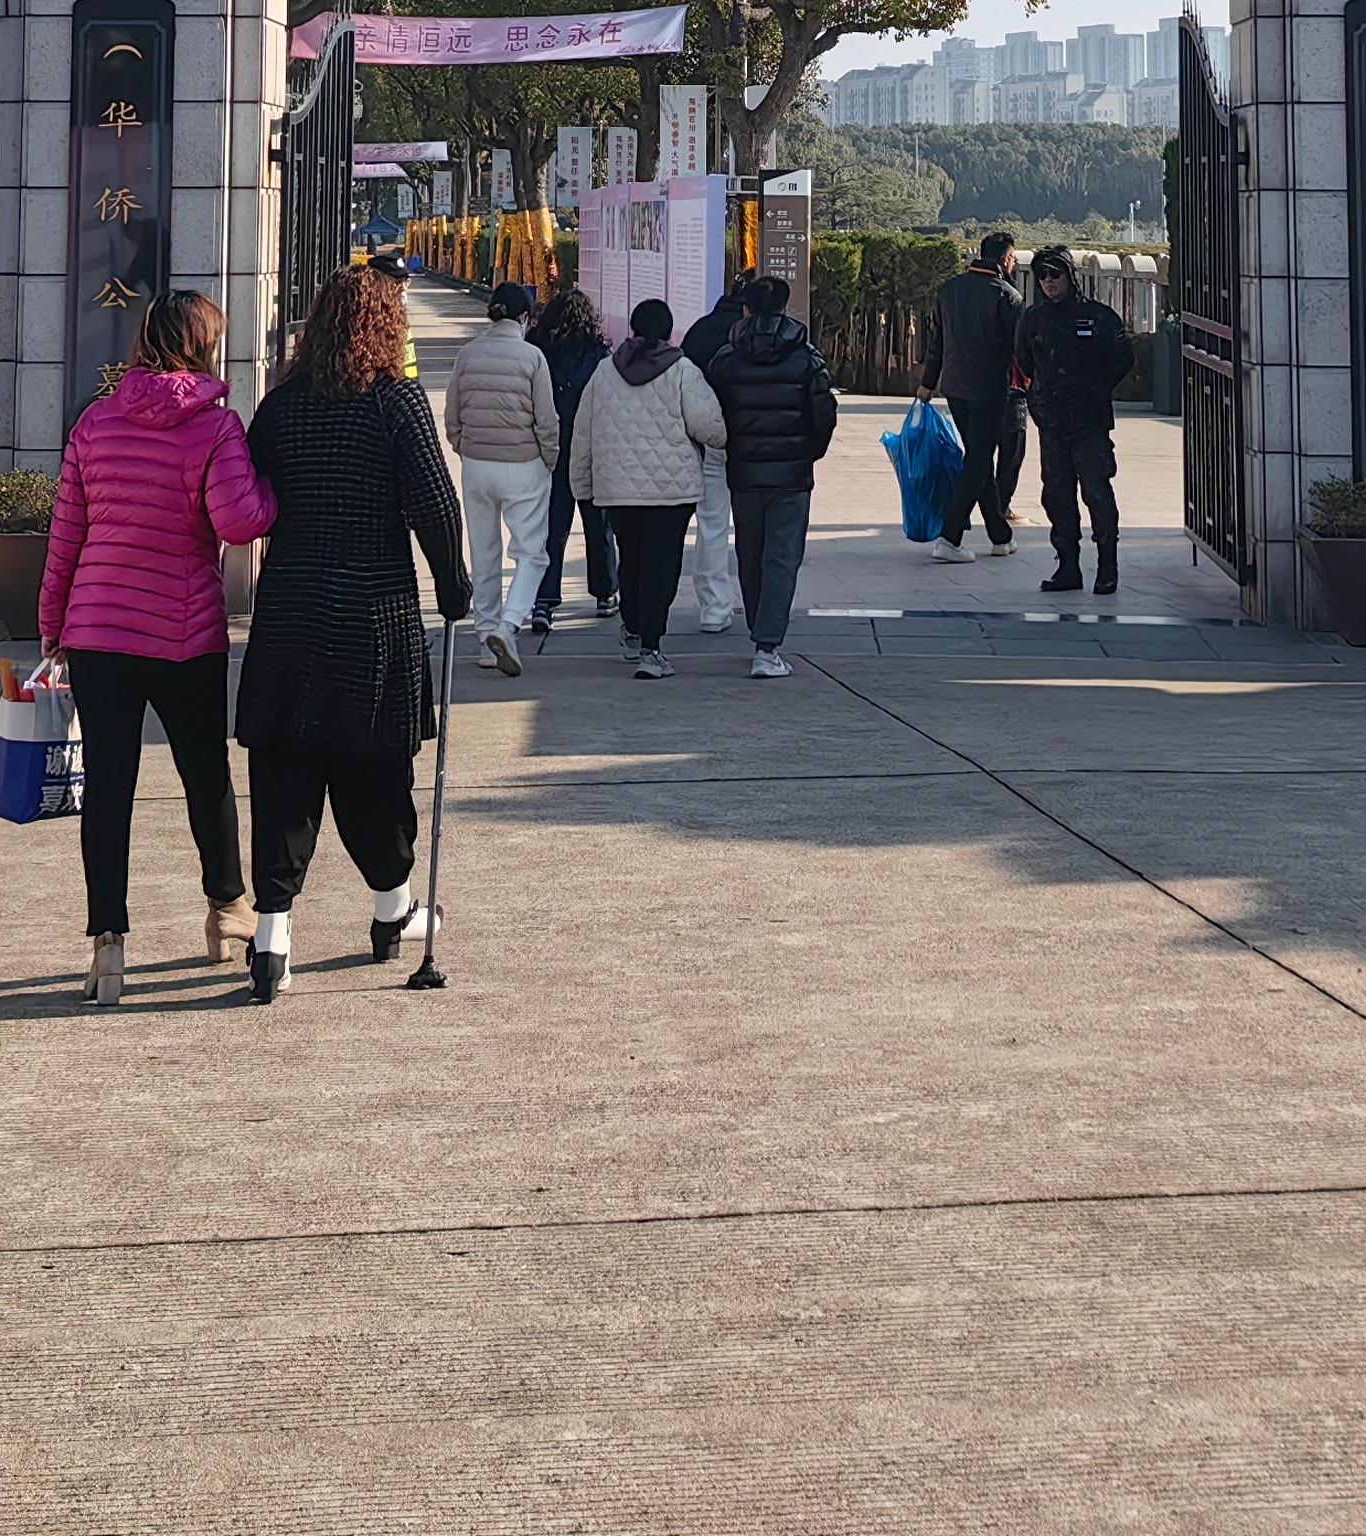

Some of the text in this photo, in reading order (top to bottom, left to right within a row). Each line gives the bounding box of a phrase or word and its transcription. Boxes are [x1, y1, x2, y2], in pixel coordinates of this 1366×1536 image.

[355, 23, 472, 54] 亲情恒远
[505, 20, 624, 52] 思念永在
